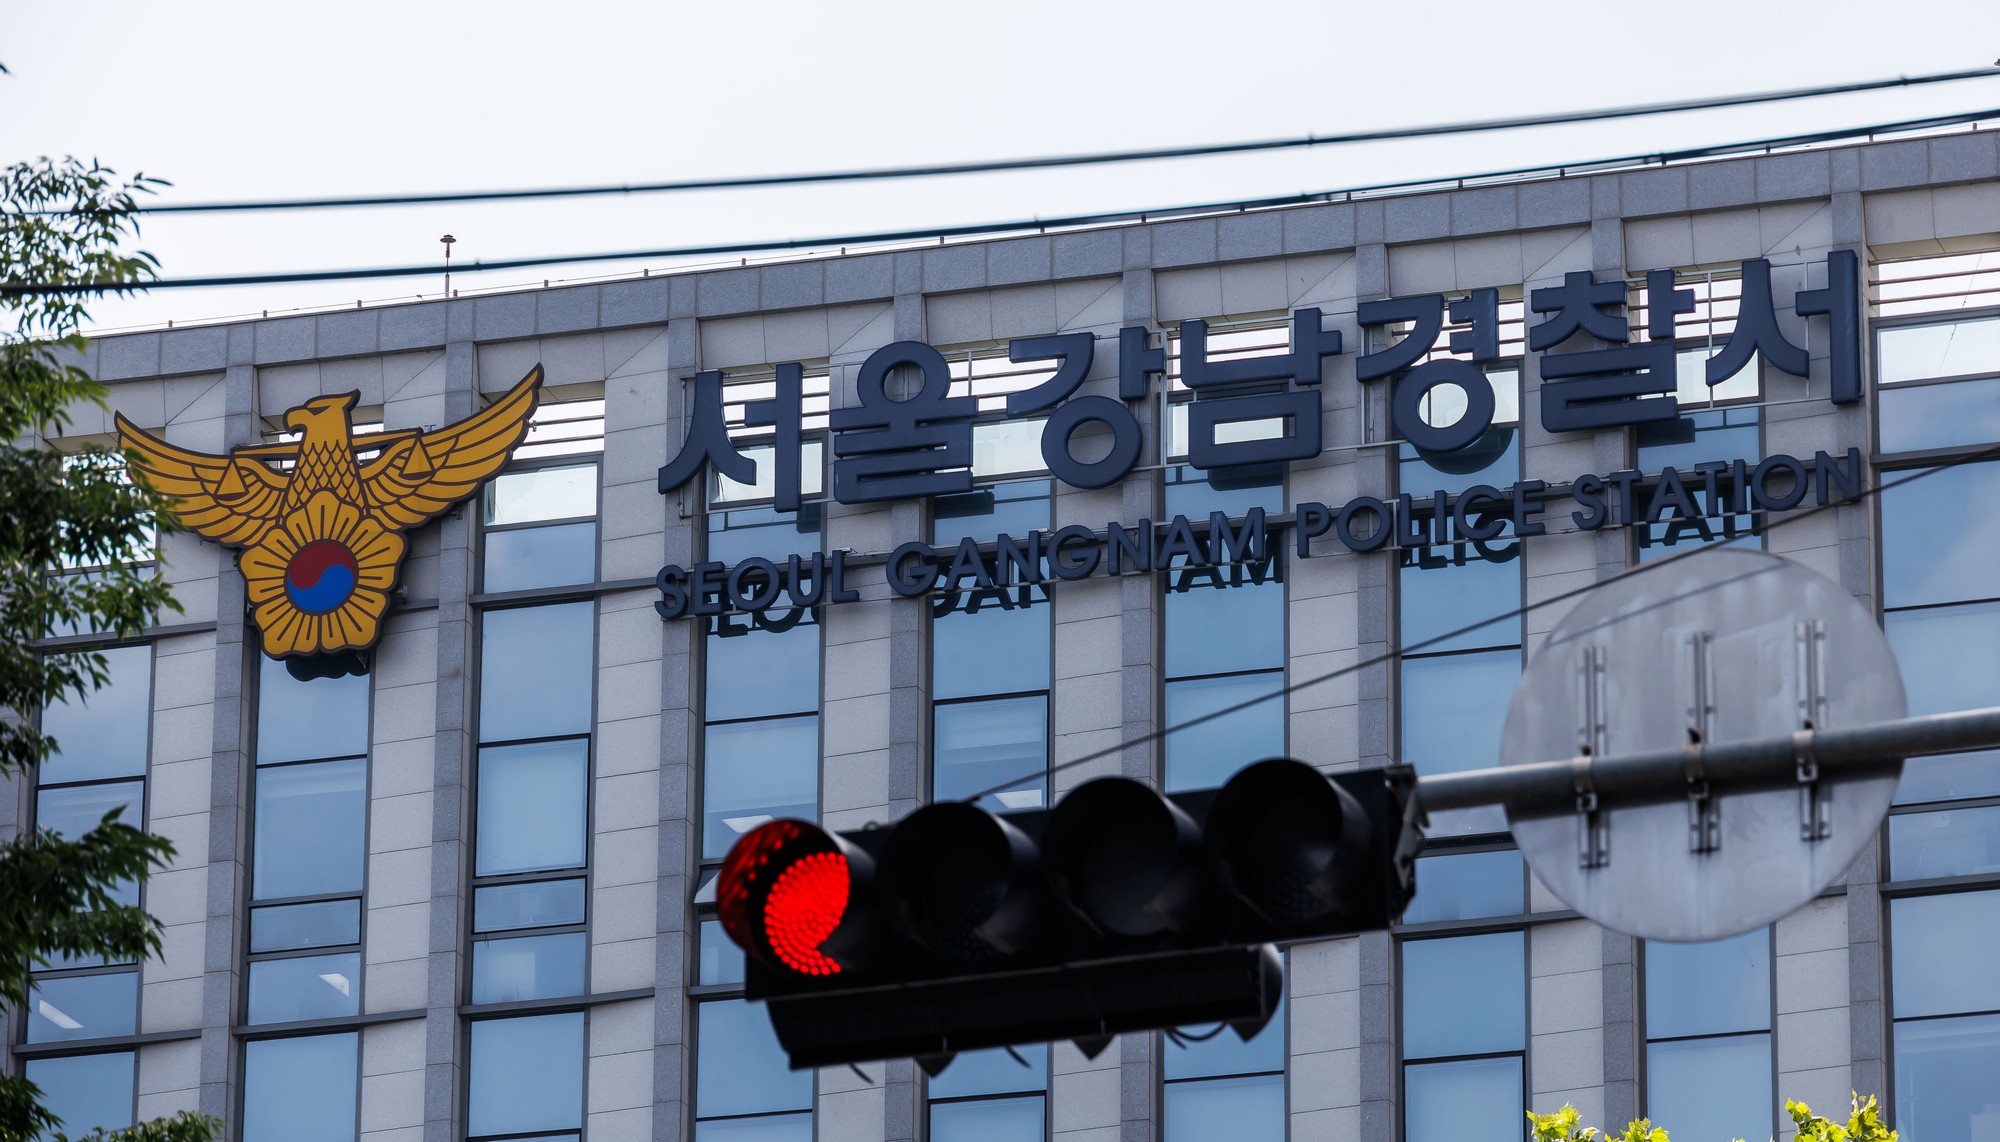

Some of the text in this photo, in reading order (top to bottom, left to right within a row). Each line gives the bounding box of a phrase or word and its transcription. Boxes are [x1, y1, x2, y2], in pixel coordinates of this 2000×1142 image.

[658, 249, 1862, 513] 서울강남경찰서
[654, 447, 1861, 620] SEOUL GANGNAM POLICE STATION
